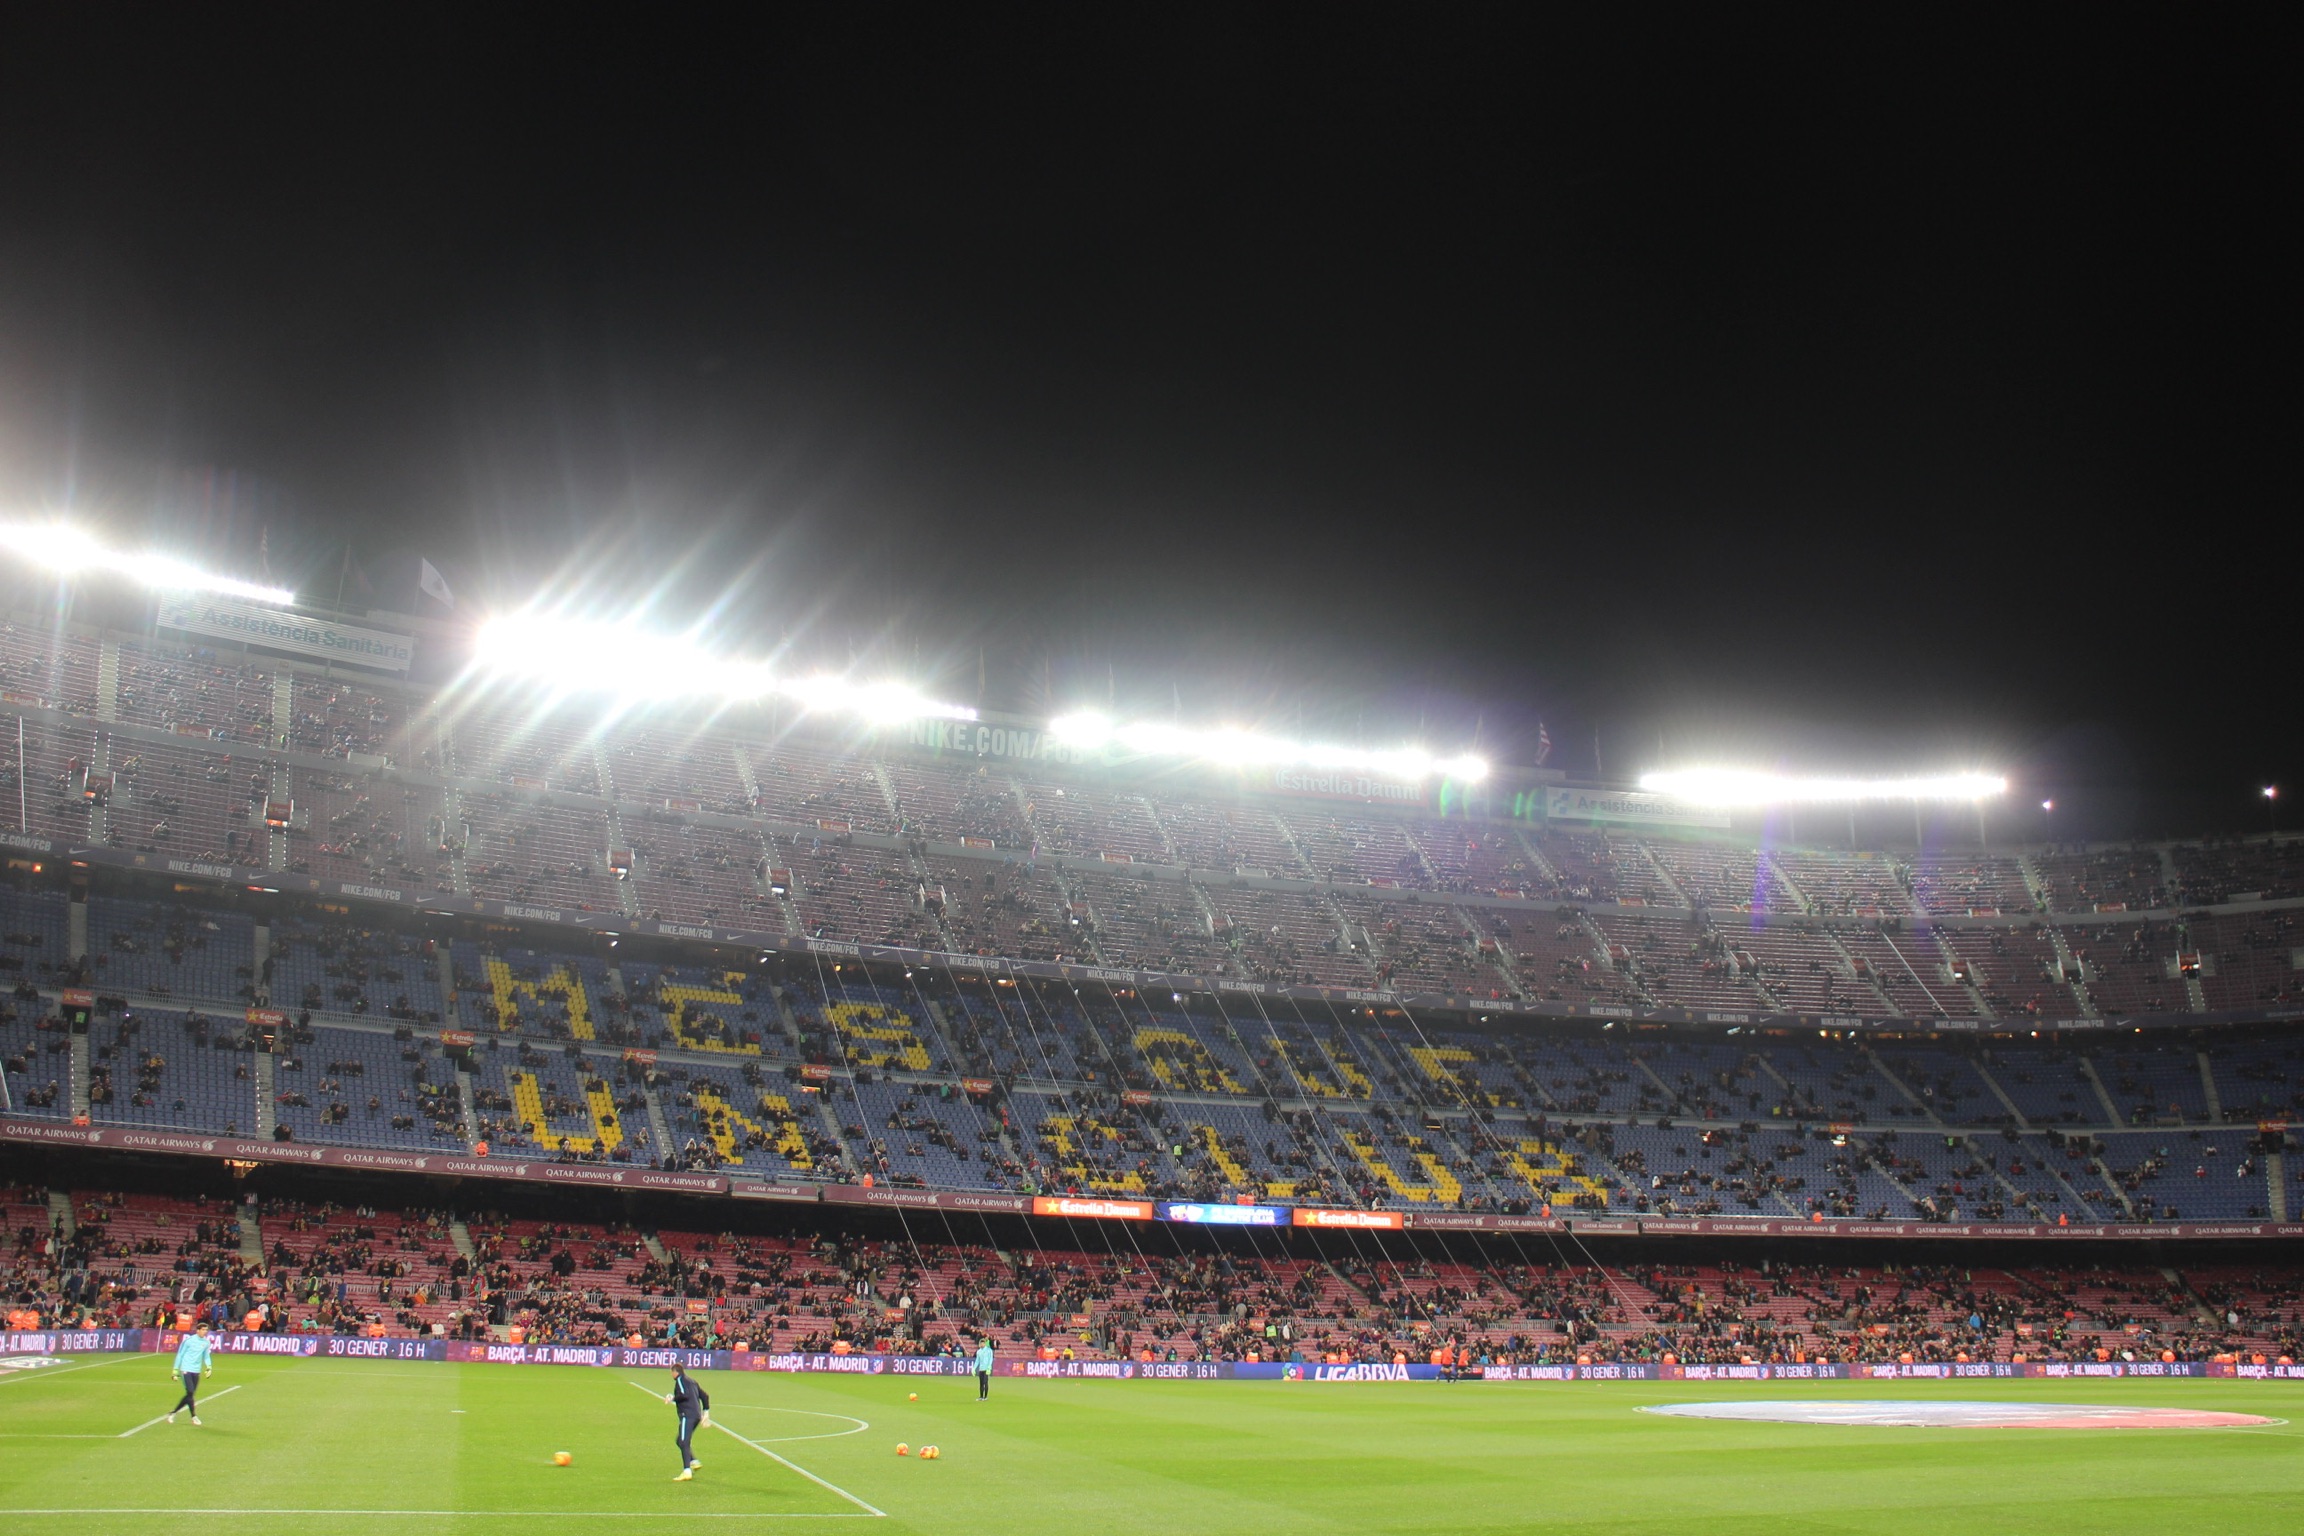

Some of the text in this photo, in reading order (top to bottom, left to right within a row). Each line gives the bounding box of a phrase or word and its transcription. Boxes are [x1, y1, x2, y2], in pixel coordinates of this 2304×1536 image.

[202, 607, 409, 659] Assistència Sanitària
[1275, 769, 1422, 800] Estrella Damm
[1577, 793, 1665, 815] Assistència
[168, 859, 232, 878] NIKE.COM/FCB
[341, 883, 401, 901] NIKE.COM/FCB
[503, 904, 561, 922] NIKE.COM/FCB
[659, 924, 713, 940] NIKE.COM/FCB
[807, 941, 859, 955] NIKE.COM/FCB
[949, 956, 1000, 970] NIKE.COM/FCB
[1086, 968, 1135, 982] NIKE.COM/FCB
[1219, 981, 1265, 993] NIKE.COM/FCB
[1346, 991, 1391, 1003] NIKE.COM/FCB
[1469, 1000, 1514, 1011] NIKE.COM/FCB
[1590, 1006, 1633, 1017] NIKE.COM/FCB
[259, 1013, 283, 1022] Estrella
[1707, 1013, 1749, 1023] NIKE.COM/FCB
[1821, 1017, 1863, 1027] NIKE.COM/FCB
[2057, 1019, 2105, 1029] NIKE.COM/FCB
[1935, 1020, 1979, 1030] NIKE.COM/FCB
[452, 1033, 474, 1042] Estrella
[636, 1052, 658, 1060] Estrella
[810, 1067, 831, 1076] Estrella
[6, 1124, 87, 1141] QATAR AIRWAYS
[124, 1134, 201, 1150] QATAR AIRWAYS
[236, 1143, 310, 1158] QATAR AIRWAYS
[343, 1152, 414, 1167] QATAR AIRWAYS
[446, 1161, 515, 1174] QATAR AIRWAYS
[546, 1168, 612, 1181] QATAR AIRWAYS
[642, 1175, 707, 1188] QATAR AIRWAYS
[747, 1184, 791, 1195] QATAR AIRWAYS
[867, 1192, 927, 1204] QATAR AIRWAYS
[955, 1197, 1013, 1209] QATAR AIRWAYS
[1060, 1200, 1140, 1216] Estrella Damm
[1318, 1211, 1392, 1226] Estrella Damm
[1423, 1216, 1475, 1226] QATAR AIRWAYS
[1498, 1218, 1549, 1228] QATAR AIRWAYS
[1599, 1222, 1617, 1230] AIRWAYS
[1642, 1222, 1692, 1231] QATAR AIRWAYS
[1713, 1224, 1760, 1232] QATAR AIRWAYS
[1781, 1225, 1830, 1233] QATAR AIRWAYS
[1849, 1226, 1896, 1234] QATAR AIRWAYS
[1916, 1227, 1963, 1235] QATAR AIRWAYS
[1982, 1227, 2029, 1235] QATAR AIRWAYS
[2048, 1228, 2095, 1236] QATAR AIRWAYS
[2118, 1228, 2172, 1236] QATAR AIRWAYS
[2195, 1226, 2252, 1235] QATAR AIRWAYS
[2277, 1226, 2303, 1235] QATAR
[10, 1335, 20, 1351] AT.
[21, 1334, 46, 1351] MADRID
[62, 1333, 125, 1350] 30 GENER 16 H
[232, 1335, 250, 1350] AT.
[253, 1337, 300, 1353] MADRID
[328, 1340, 425, 1357] 30 GENER 16 H
[488, 1346, 597, 1364] BARÇA AT. MADRID
[623, 1351, 711, 1367] 30 GENER 16 H
[769, 1355, 869, 1373] BARÇA AT. MADRID
[893, 1358, 974, 1374] 30 GENER 16 H
[1027, 1363, 1120, 1378] BARÇA AT. MADRID
[1142, 1364, 1217, 1378] 30 GENER 16 H
[1581, 1366, 1645, 1379] 30 GENER 16 H
[1775, 1365, 1835, 1378] 30 GENER 16 H
[1873, 1365, 1940, 1380] BARÇA AT. MADRID
[1955, 1364, 2012, 1377] 30 GENER 16 H
[2046, 1364, 2112, 1378] BARÇA AT. MADRID
[2128, 1364, 2189, 1376] 30 GENER 16 H
[2237, 1365, 2267, 1379] BARÇA
[2274, 1366, 2287, 1377] AT.
[1485, 1366, 1562, 1380] BARÇA AT. MADRID
[1685, 1366, 1758, 1380] BARÇA AT. MADRID
